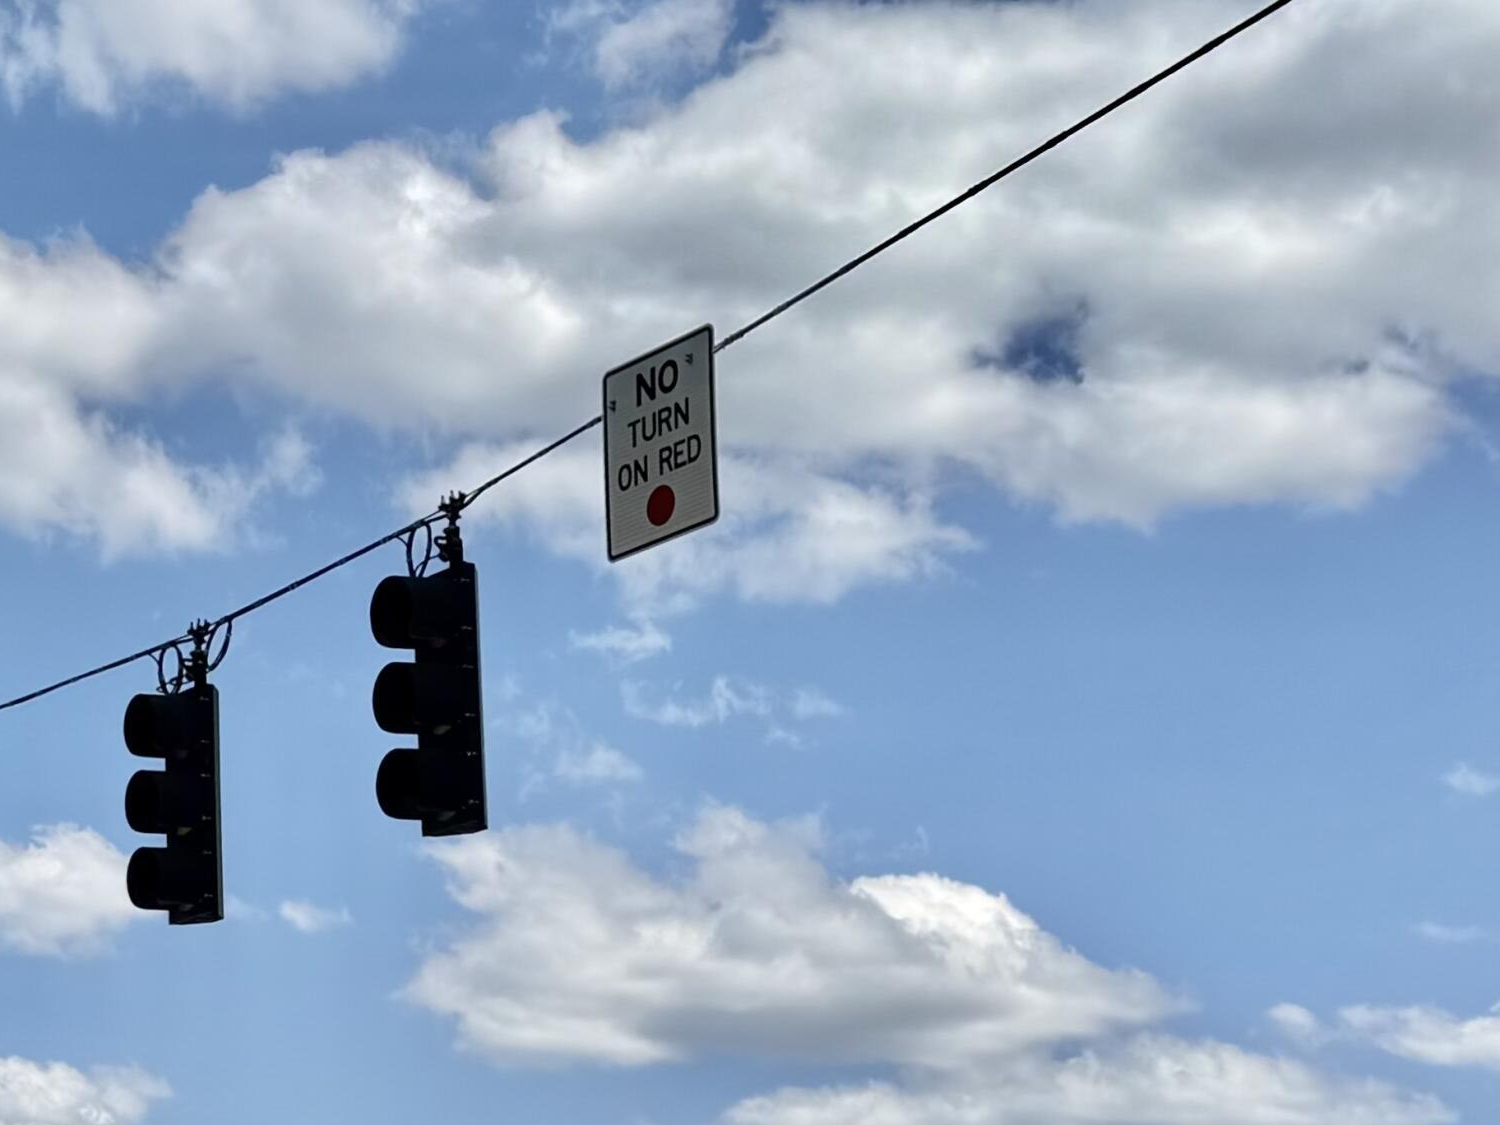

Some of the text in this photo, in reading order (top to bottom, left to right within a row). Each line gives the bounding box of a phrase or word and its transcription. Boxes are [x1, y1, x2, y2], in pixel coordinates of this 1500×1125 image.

[636, 359, 679, 408] NO
[627, 396, 690, 448] TURN
[617, 433, 702, 492] ON RED
